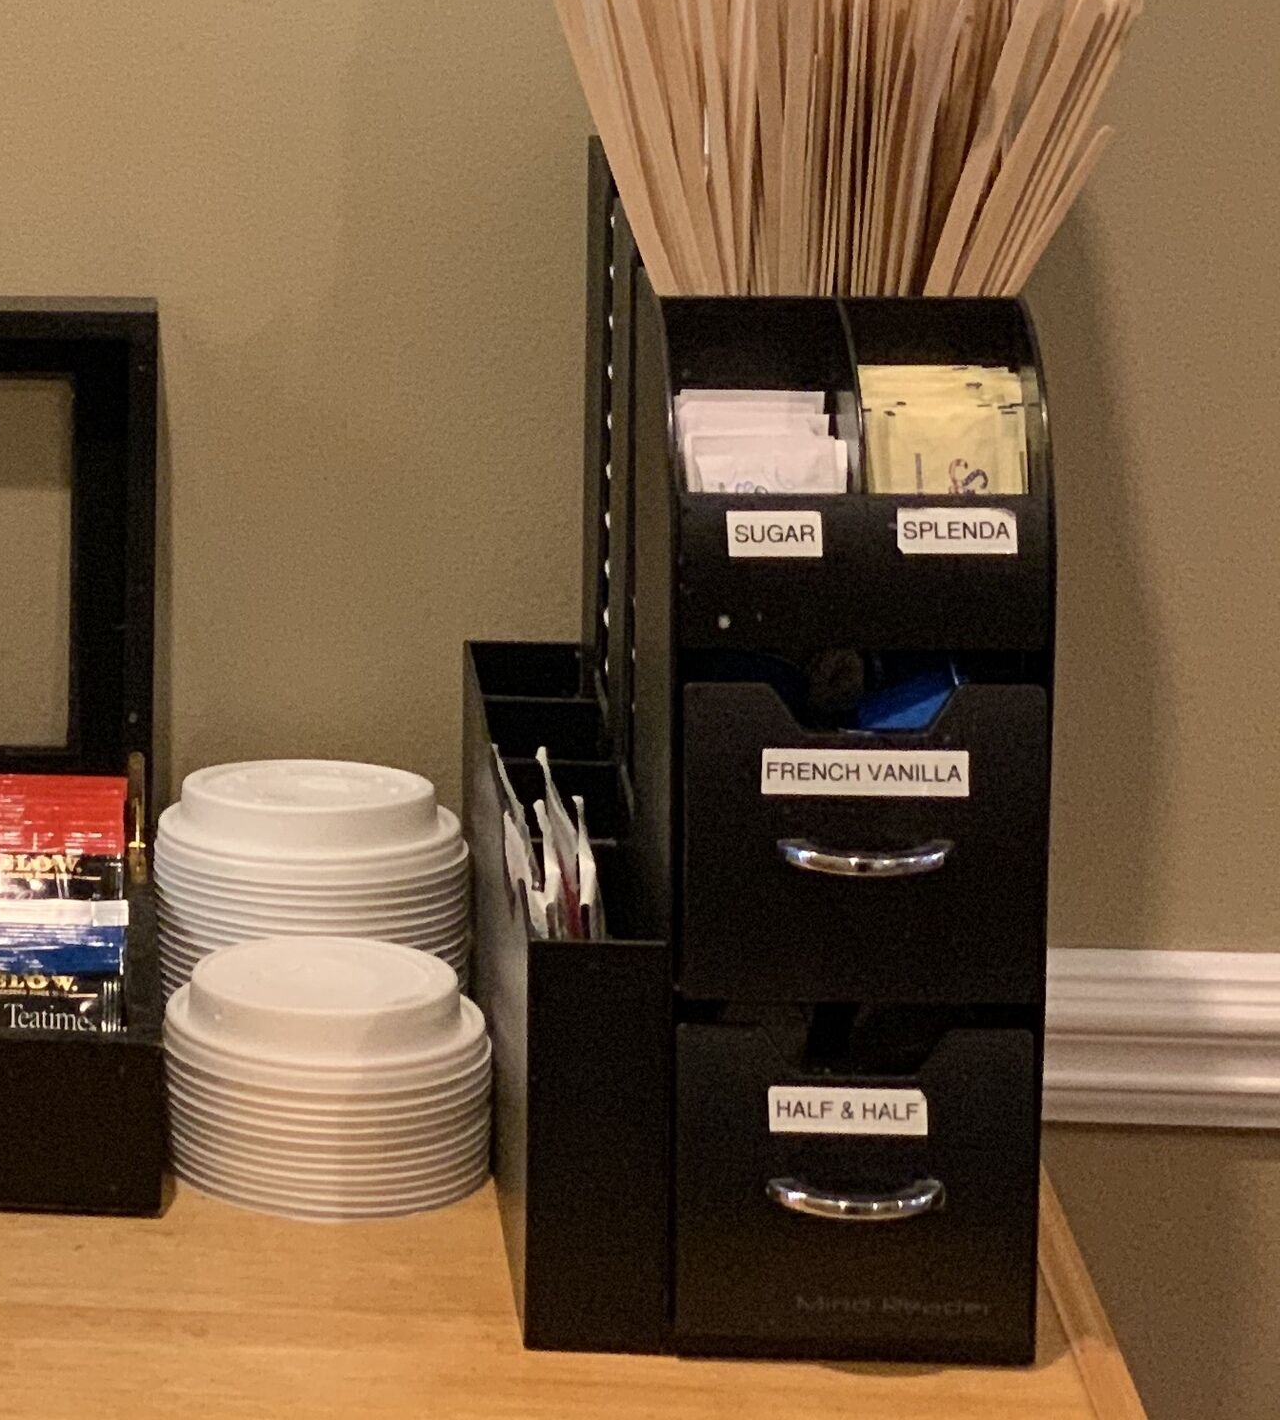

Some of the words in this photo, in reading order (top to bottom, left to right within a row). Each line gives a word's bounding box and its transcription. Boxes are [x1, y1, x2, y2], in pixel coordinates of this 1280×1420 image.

[734, 524, 816, 544] SUGAR
[902, 520, 1011, 541] SPLENDA
[766, 761, 861, 782] FRENCH
[867, 763, 962, 783] VANILLA
[776, 1099, 834, 1119] HALF
[840, 1100, 854, 1120] &
[862, 1102, 920, 1122] HALF
